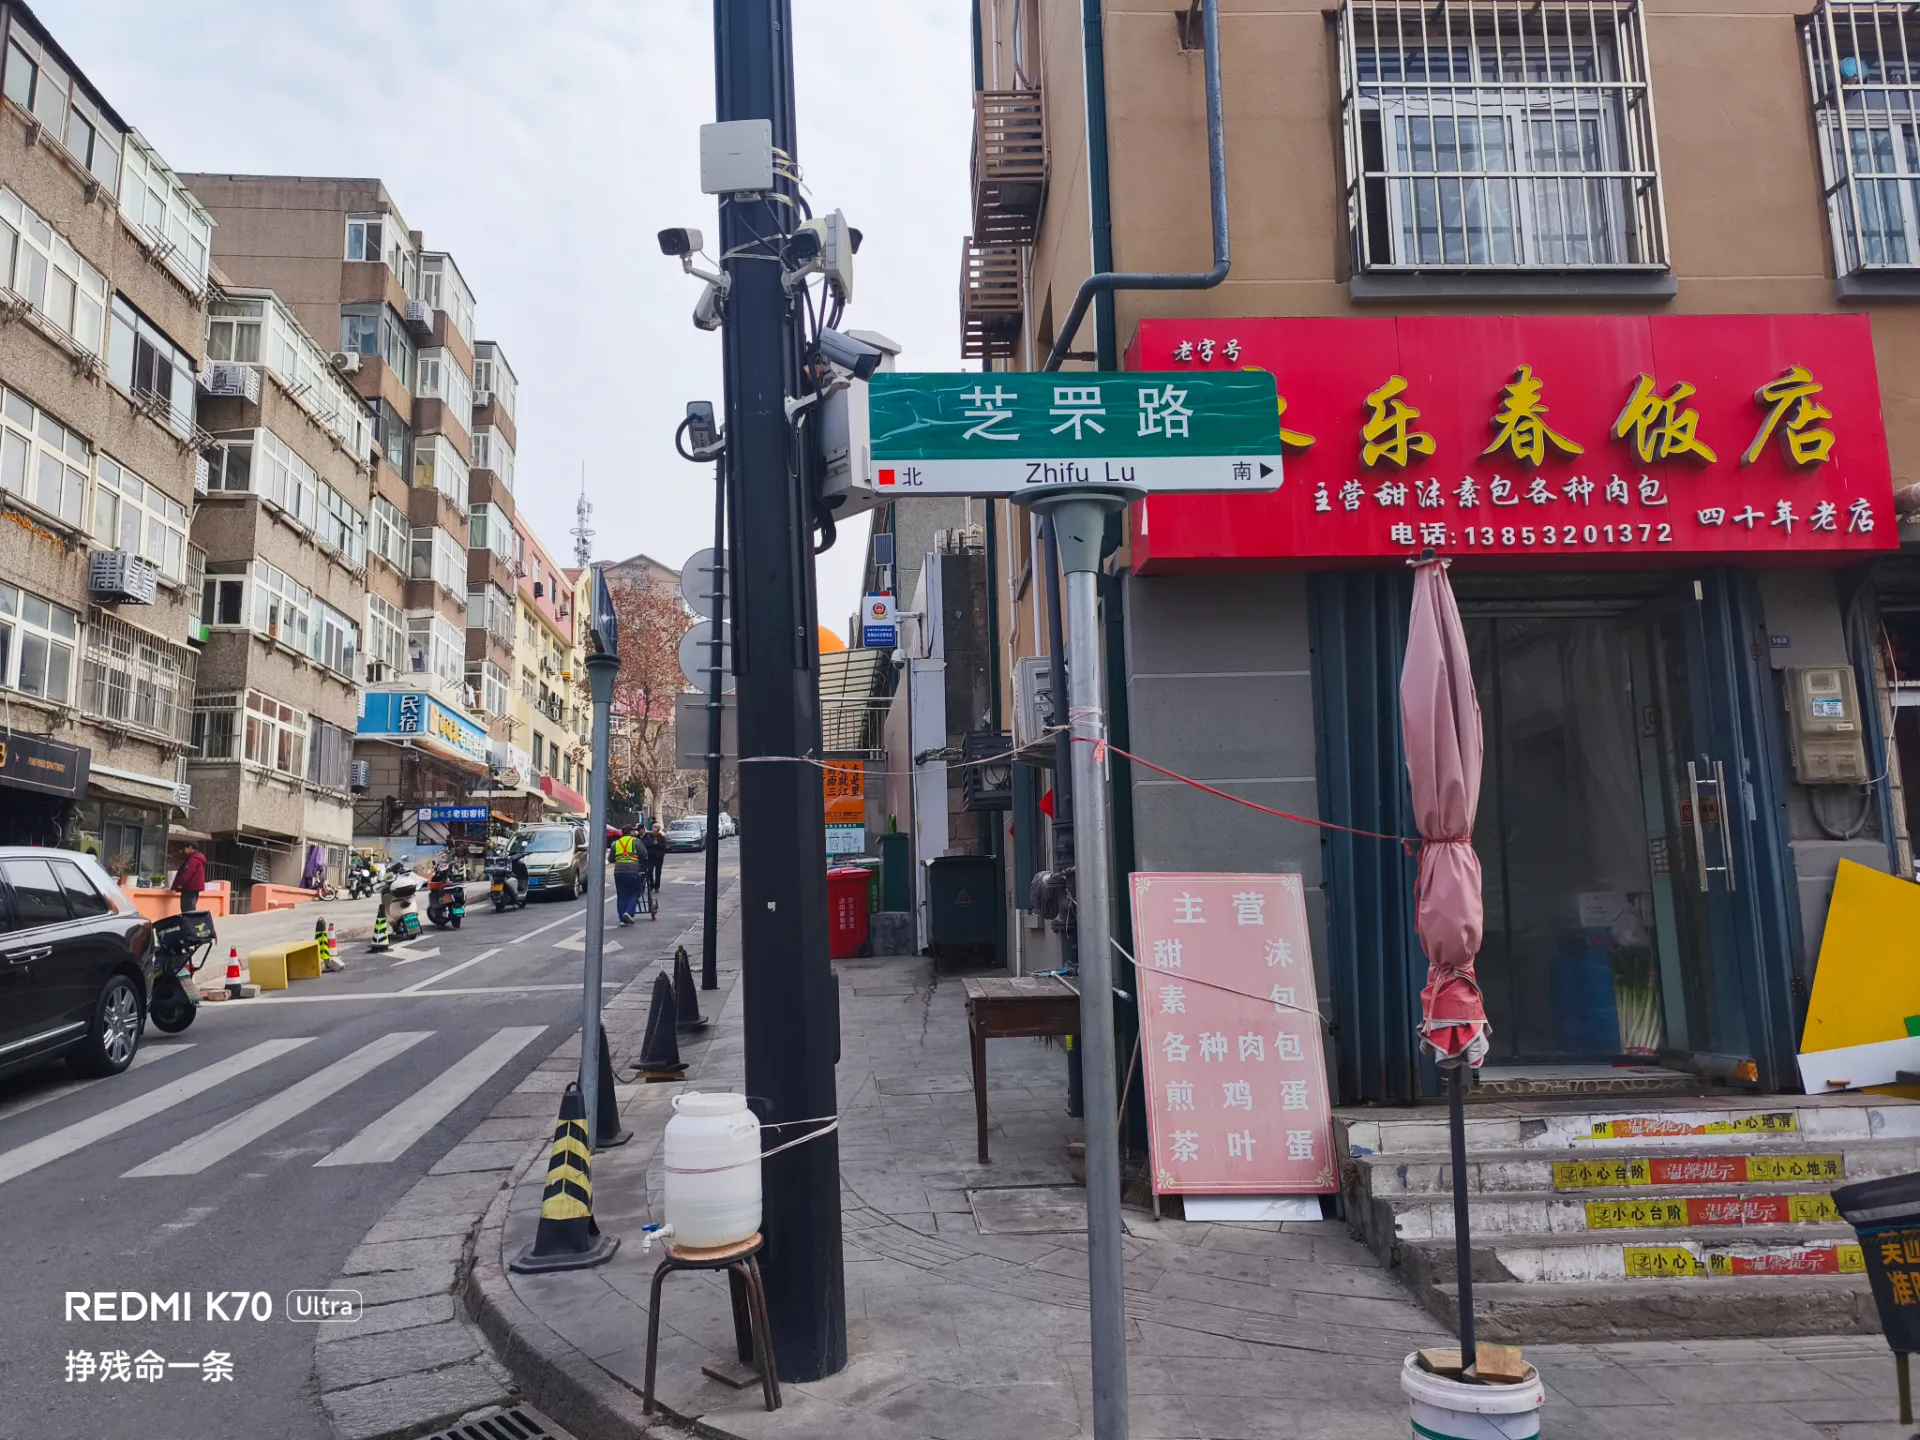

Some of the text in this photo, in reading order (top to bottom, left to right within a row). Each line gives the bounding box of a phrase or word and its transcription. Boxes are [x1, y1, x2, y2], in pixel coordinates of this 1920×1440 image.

[1175, 338, 1242, 362] 老字号
[959, 384, 1194, 440] 芝罘路
[1243, 364, 1836, 468] 乐春饭店
[902, 467, 923, 486] 北
[1025, 461, 1135, 484] Zhifu Lu
[1231, 461, 1252, 481] 南
[1313, 474, 1668, 512] 主营甜沫素包各种肉包
[1697, 498, 1875, 535] 四十年老店
[399, 695, 419, 732] 民宿
[1173, 892, 1266, 926] 主营
[1161, 1031, 1305, 1062] 各种肉包
[1165, 1079, 1310, 1112] 煎鸡蛋
[1169, 1130, 1315, 1162] 茶叶蛋
[1579, 1161, 1838, 1181] 小心台阶 温馨提示 小心地滑
[1612, 1202, 1841, 1222] 小心台阶 温馨提示 小
